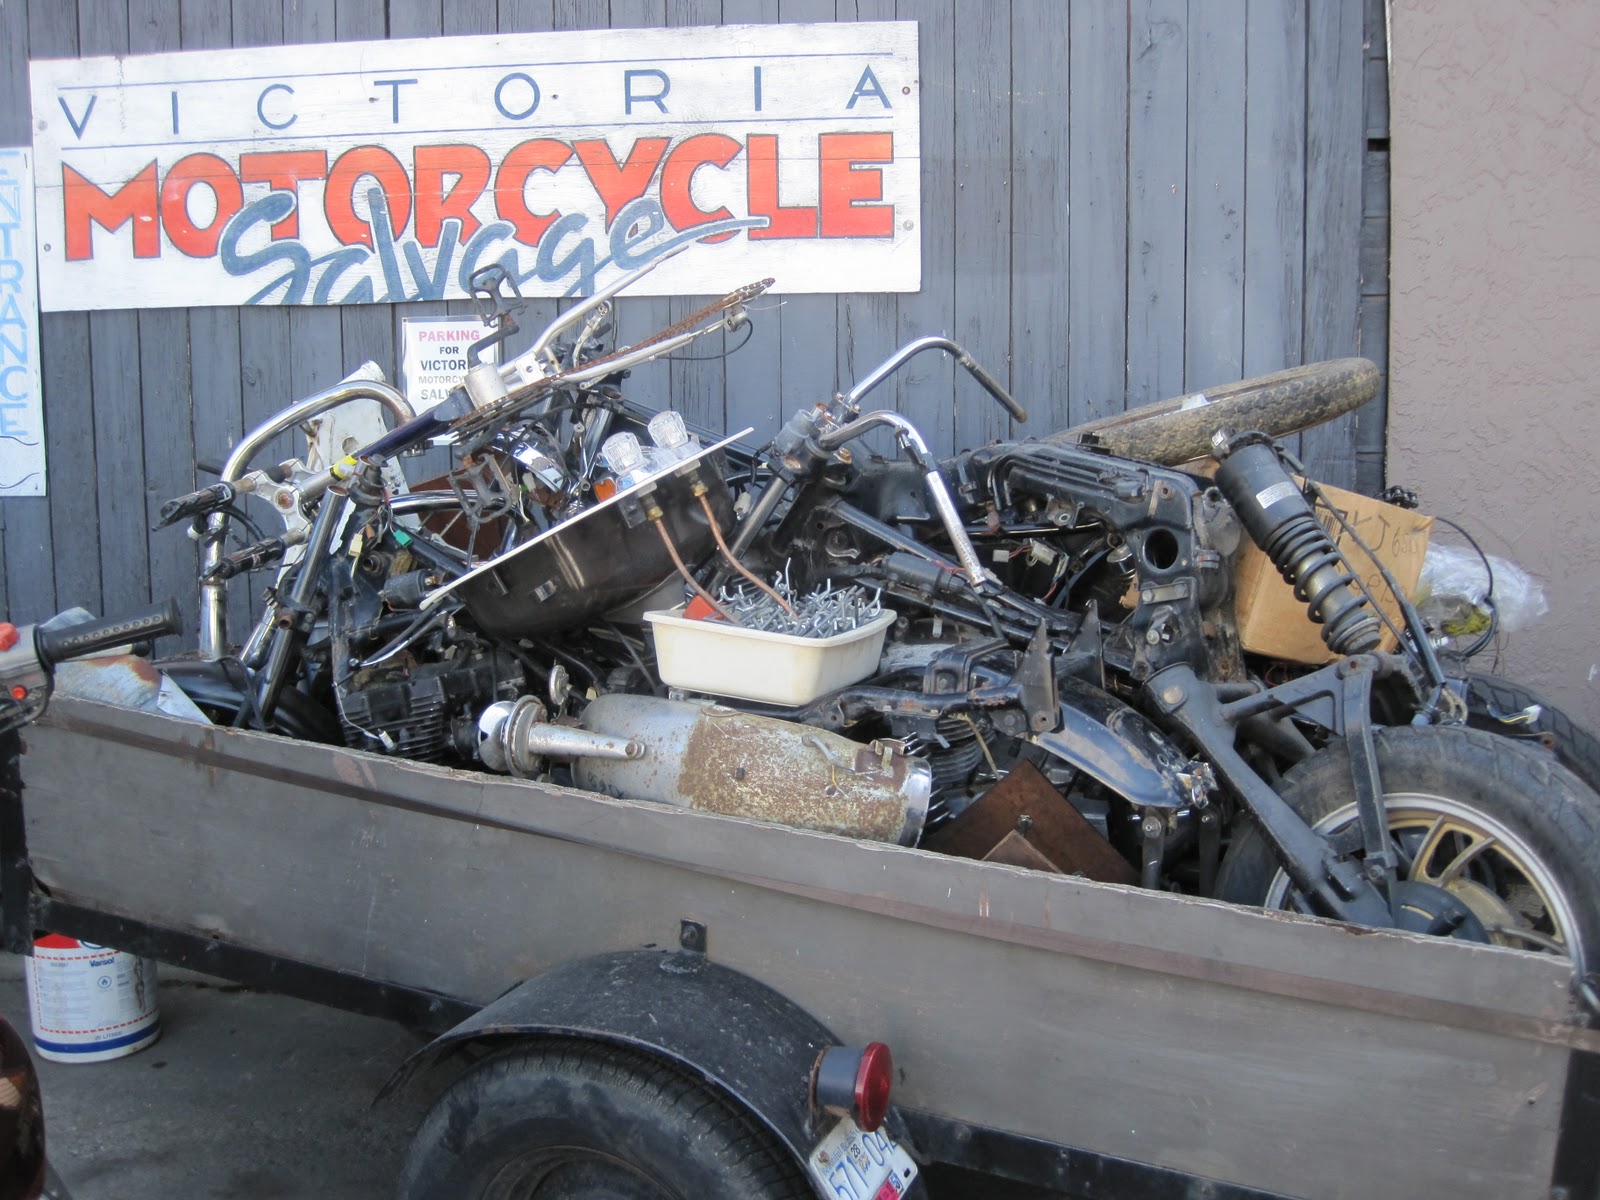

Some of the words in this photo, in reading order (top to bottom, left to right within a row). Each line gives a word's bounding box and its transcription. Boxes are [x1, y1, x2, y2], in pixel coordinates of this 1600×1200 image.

[58, 65, 892, 139] VICTORIA
[62, 132, 896, 262] MOTORCYCLE
[219, 187, 771, 307] Salvage
[418, 329, 480, 341] PARKING
[439, 346, 460, 355] FOR
[420, 359, 467, 371] VICTOR
[418, 376, 464, 385] MOTORCY
